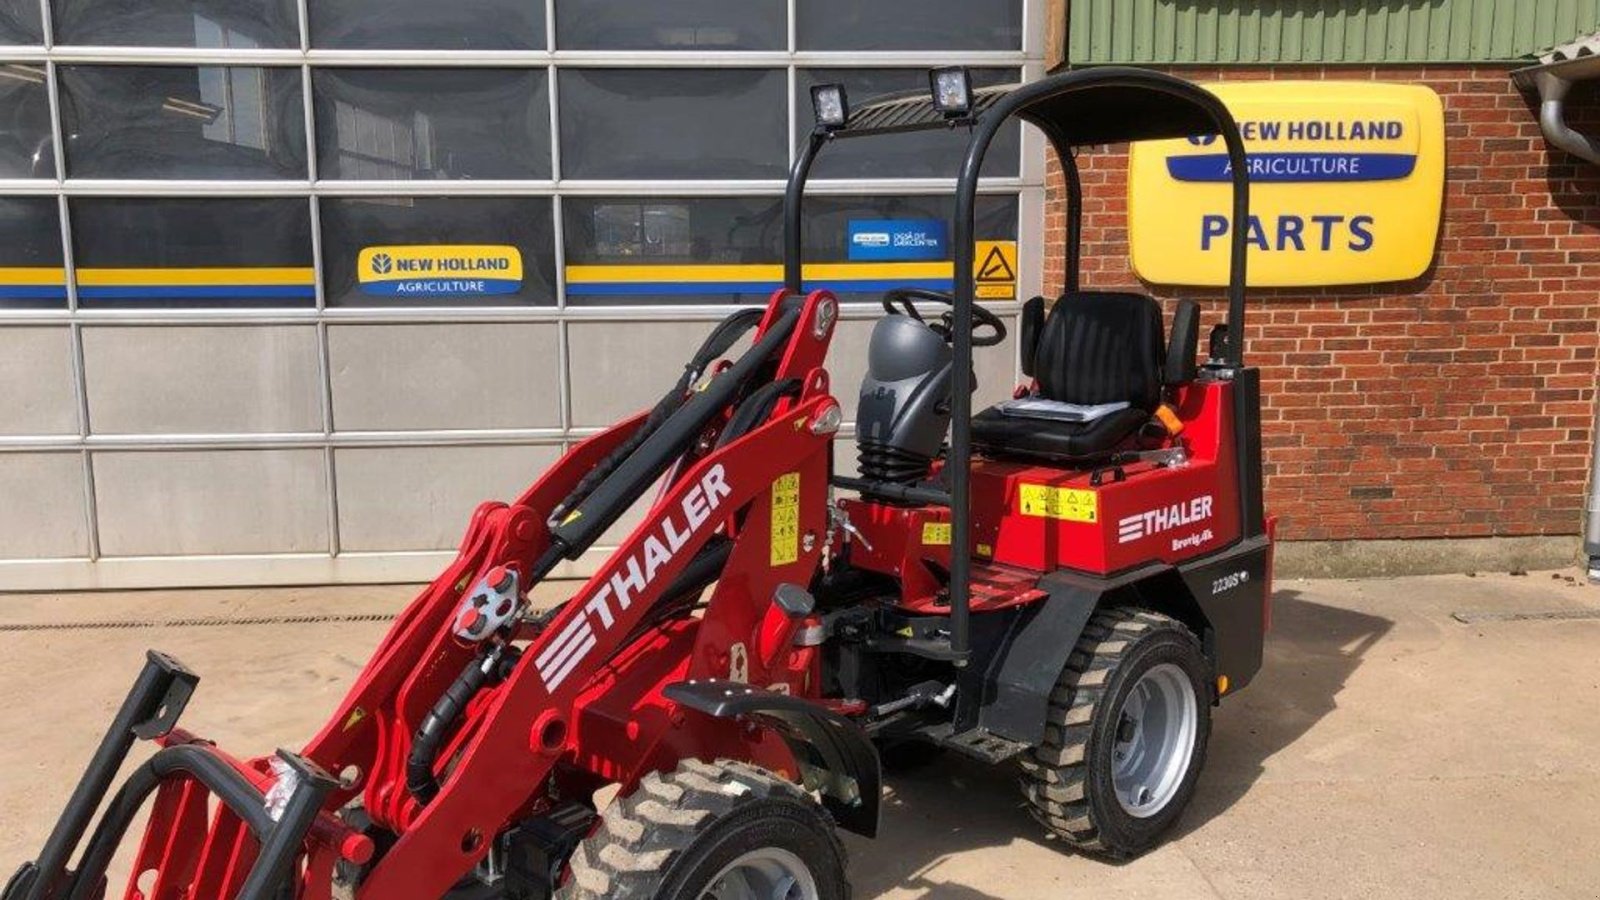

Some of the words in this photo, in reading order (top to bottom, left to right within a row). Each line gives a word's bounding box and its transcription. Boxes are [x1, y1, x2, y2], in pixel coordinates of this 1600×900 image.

[1287, 121, 1403, 141] HOLLAND
[1200, 214, 1375, 252] PARTS
[396, 258, 433, 271] NEW
[437, 257, 509, 271] HOLLAND
[396, 281, 485, 293] AGRICULTURE
[1143, 495, 1213, 536] THALER
[585, 463, 732, 630] THALER
[1212, 572, 1239, 595] 2230S
